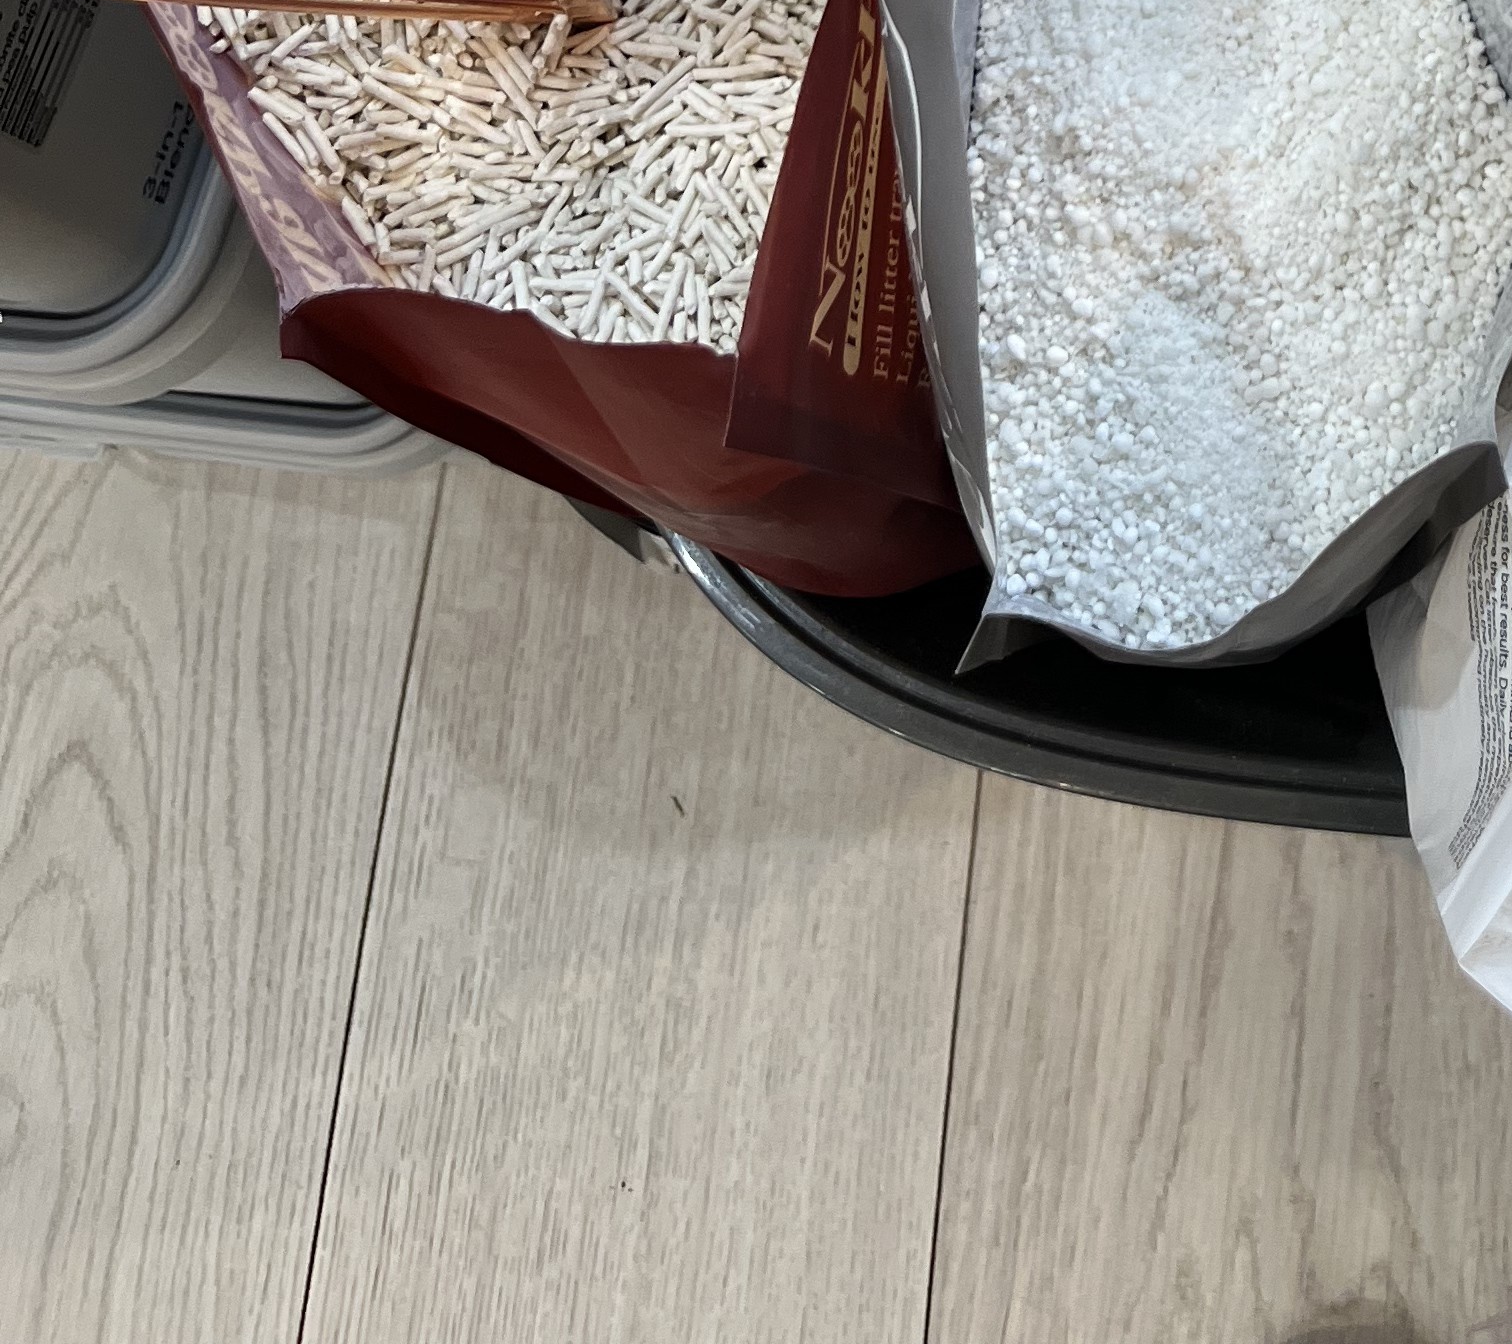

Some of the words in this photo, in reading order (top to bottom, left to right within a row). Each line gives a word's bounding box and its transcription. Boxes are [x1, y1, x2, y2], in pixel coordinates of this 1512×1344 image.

[143, 100, 185, 202] 3-in-1
[876, 238, 899, 332] litter
[873, 334, 890, 380] Fill
[896, 289, 920, 386] Liqui
[1500, 546, 1509, 569] for
[1499, 572, 1509, 610] best
[1498, 612, 1509, 671] results.
